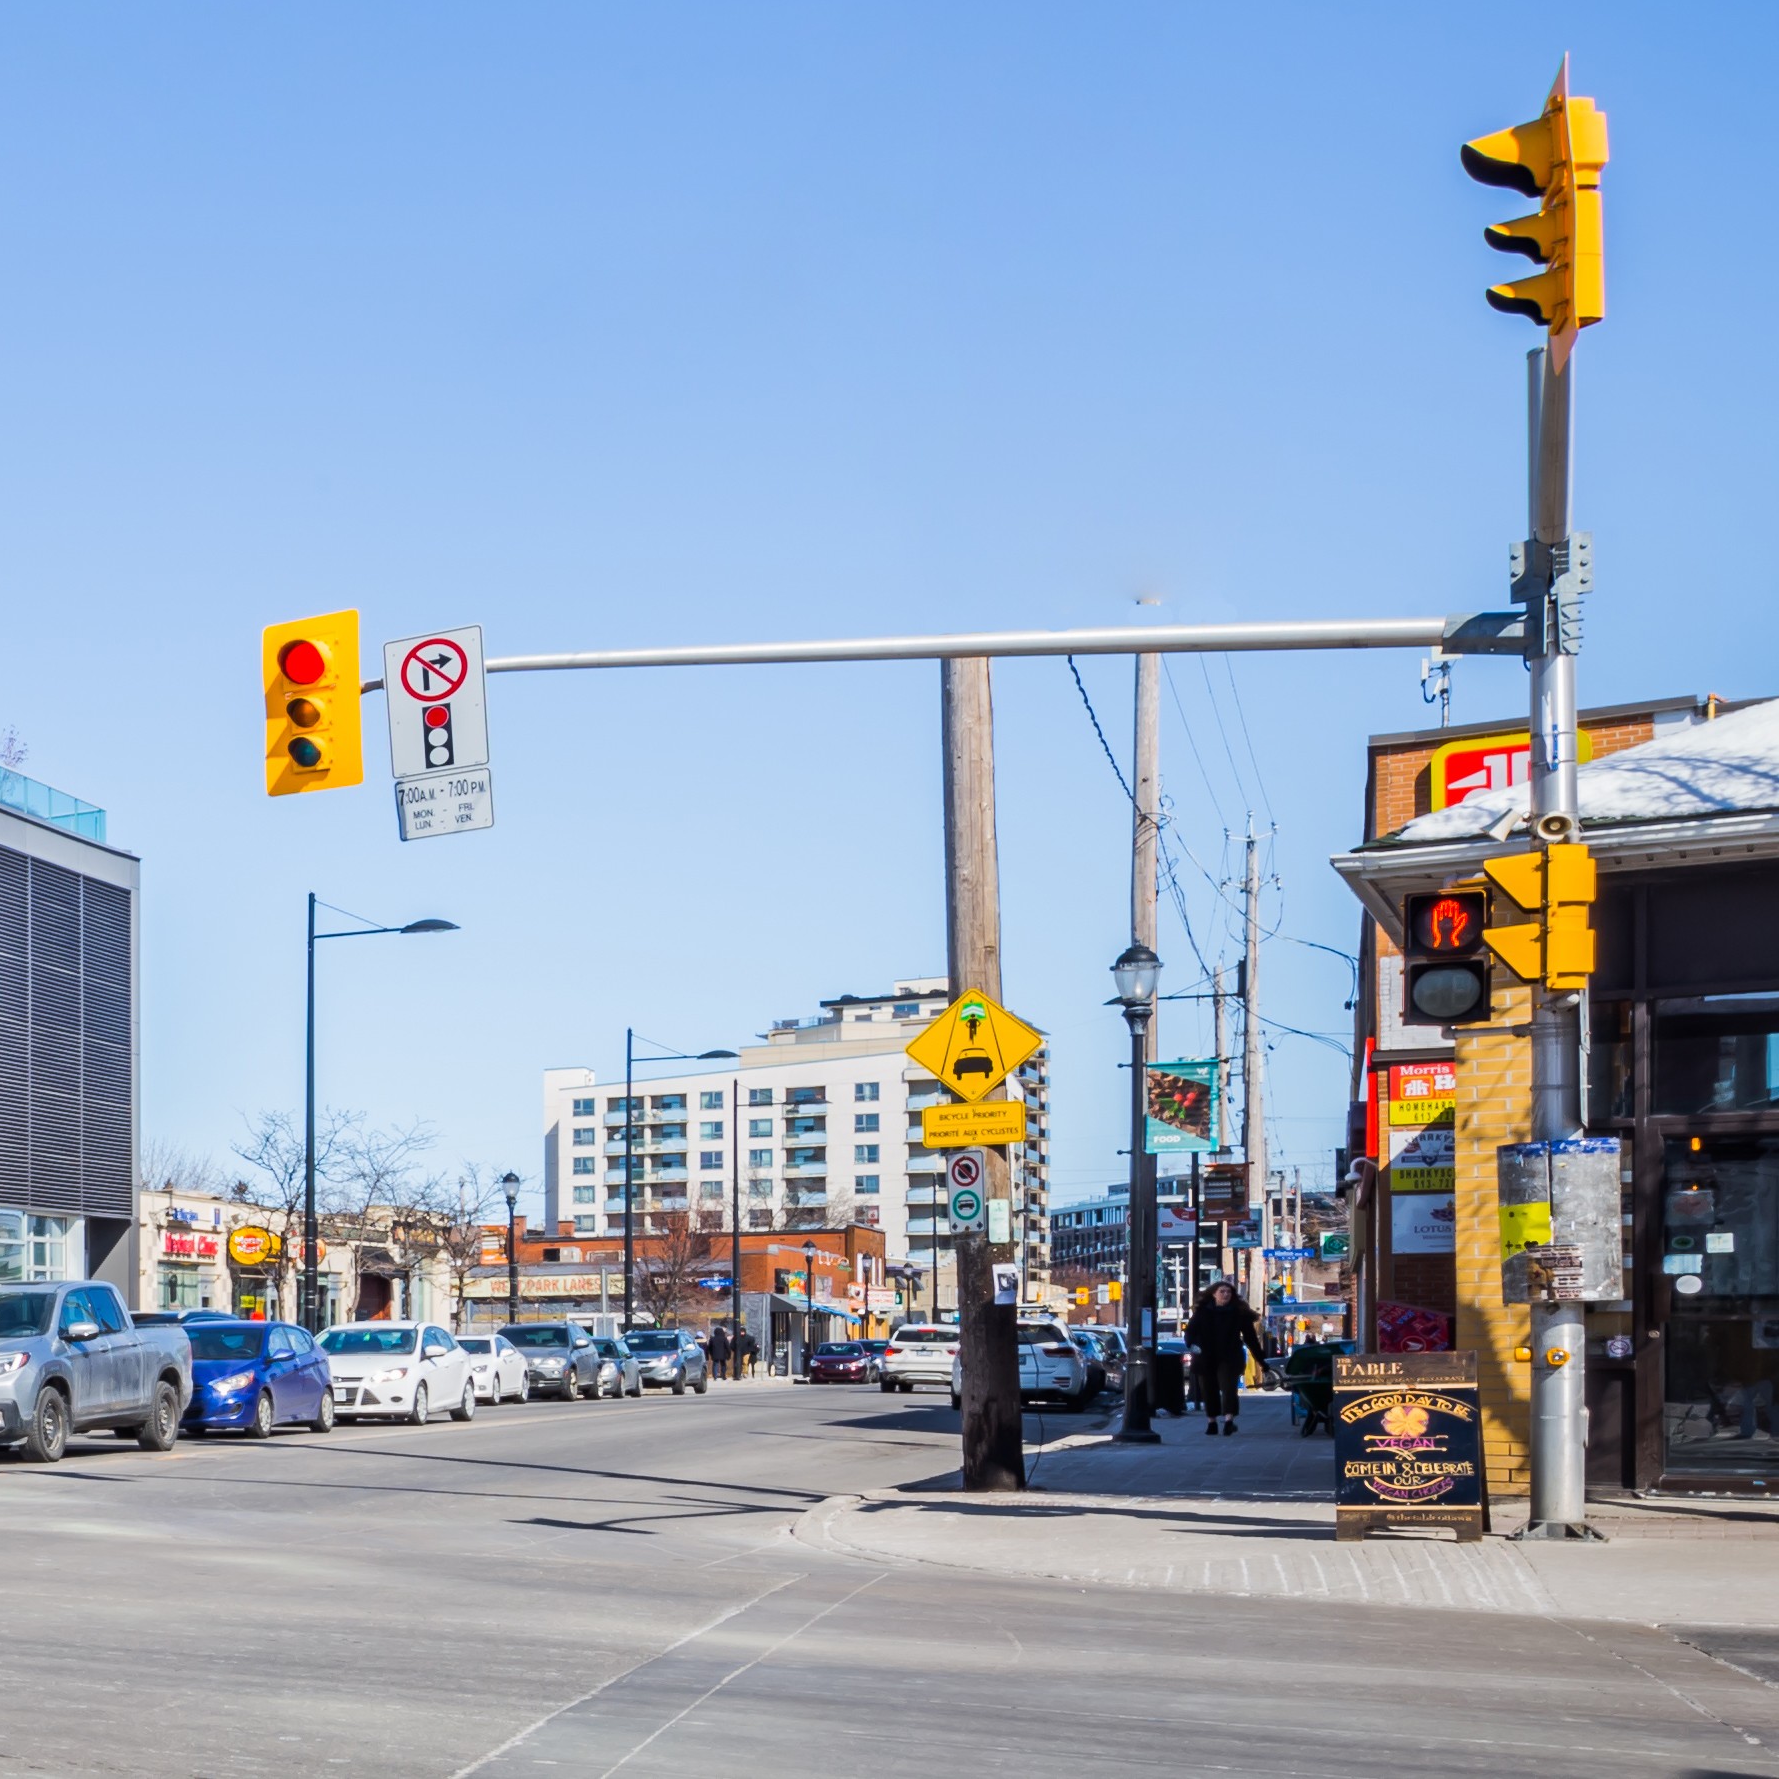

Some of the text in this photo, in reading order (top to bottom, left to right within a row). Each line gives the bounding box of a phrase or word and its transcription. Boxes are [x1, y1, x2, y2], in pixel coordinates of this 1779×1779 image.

[448, 778, 469, 798] 7:00
[413, 808, 435, 820] MON.
[414, 819, 434, 831] LUN.
[455, 812, 474, 824] VEN.
[1399, 1065, 1450, 1076] Morris
[939, 1109, 1007, 1122] BICYCLE PRIORITY
[963, 1127, 979, 1137] AUX
[980, 1125, 1019, 1136] CYCLISTES
[1153, 1134, 1181, 1144] FOOD
[1414, 1224, 1452, 1234] LOTUS
[526, 1279, 559, 1294] PARK
[563, 1277, 601, 1292] LANES
[1337, 1362, 1404, 1376] TABLE
[1371, 1394, 1403, 1409] GOOD
[1405, 1394, 1432, 1406] DAY
[1436, 1397, 1453, 1409] TO
[1375, 1437, 1436, 1449] VEGAN
[1344, 1463, 1379, 1476] COME
[1382, 1462, 1397, 1475] IN
[1414, 1461, 1474, 1474] CELEBRATE
[1372, 1477, 1455, 1499] VEGAN CHOICES
